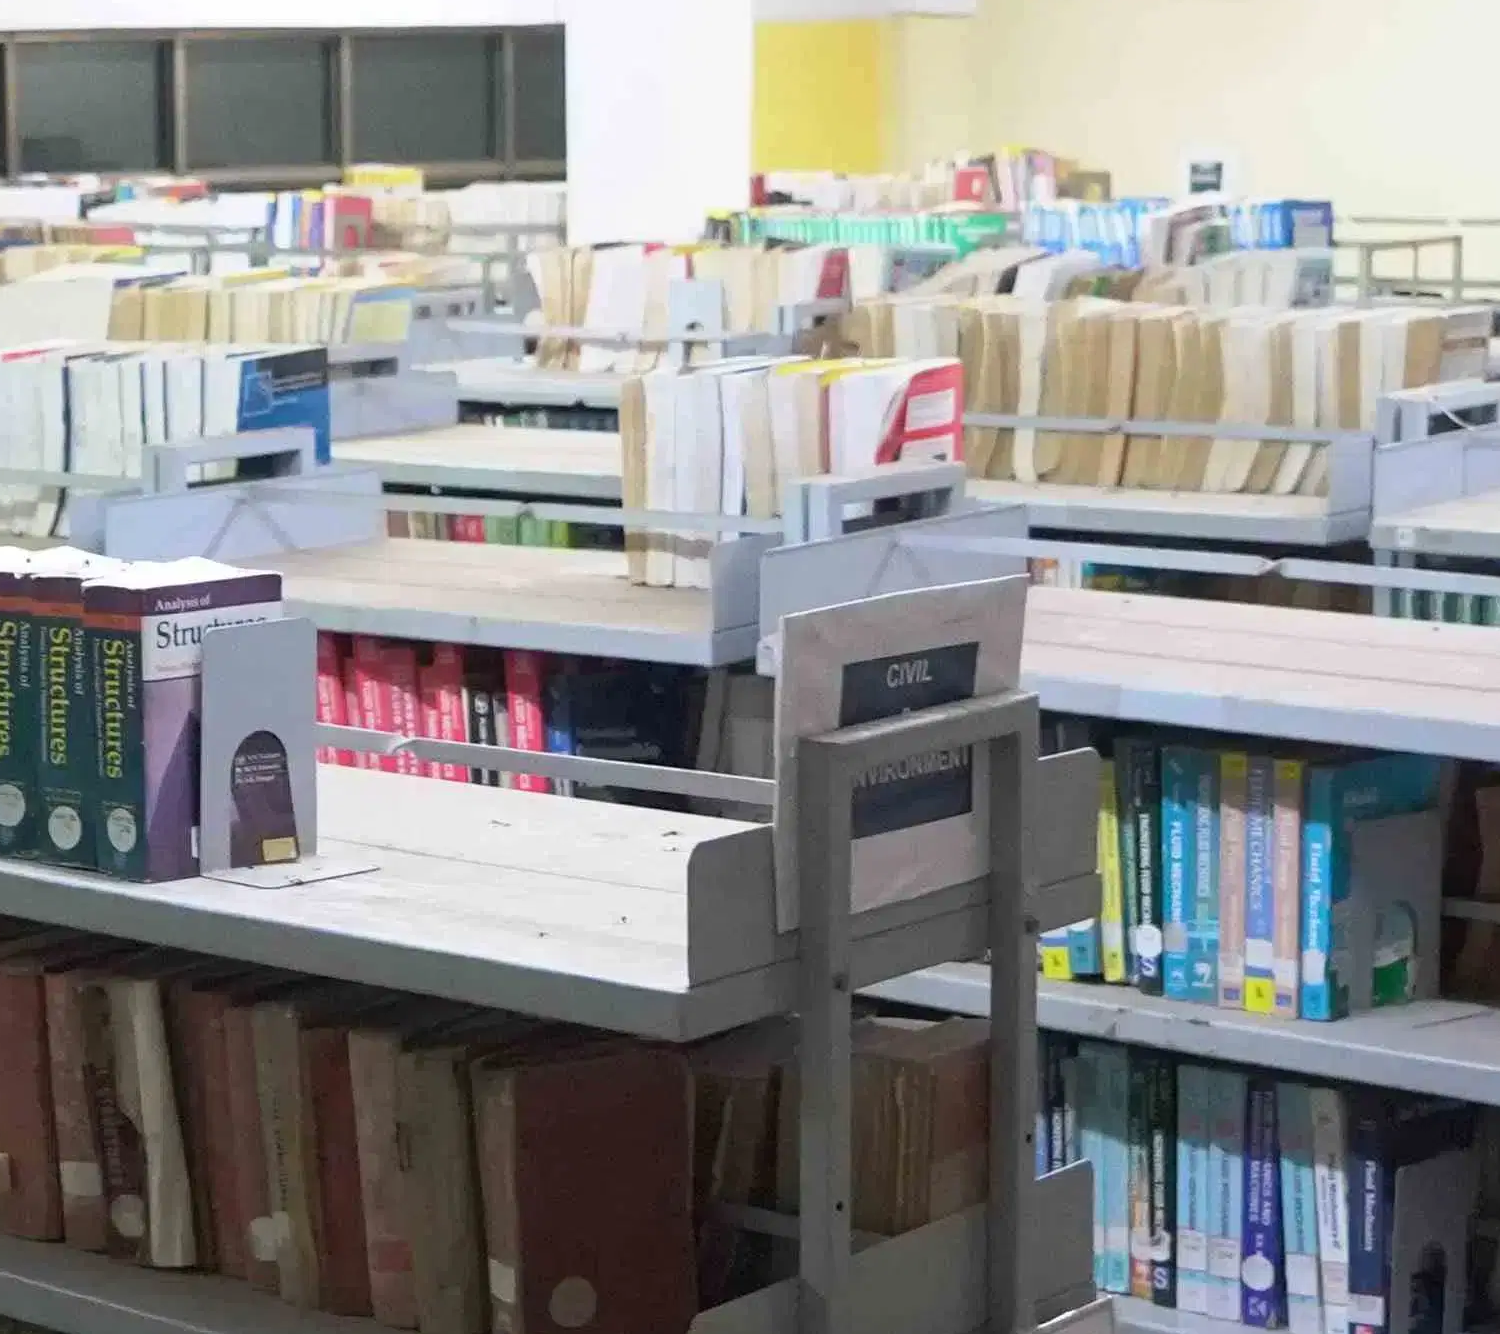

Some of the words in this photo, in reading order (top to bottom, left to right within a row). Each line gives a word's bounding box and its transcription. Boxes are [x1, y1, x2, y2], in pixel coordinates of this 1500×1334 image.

[155, 597, 198, 611] Analysis
[199, 593, 210, 607] of
[20, 621, 30, 671] Analysis
[74, 628, 84, 681] Analysis
[127, 640, 136, 692] Analysis
[20, 676, 30, 687] of
[76, 684, 85, 695] of
[887, 659, 933, 689] CIVIL
[49, 627, 71, 765] Structures
[102, 639, 125, 778] Structures
[127, 696, 136, 708] of
[1171, 821, 1183, 858] FLUID
[1250, 816, 1264, 911] MECHANICS
